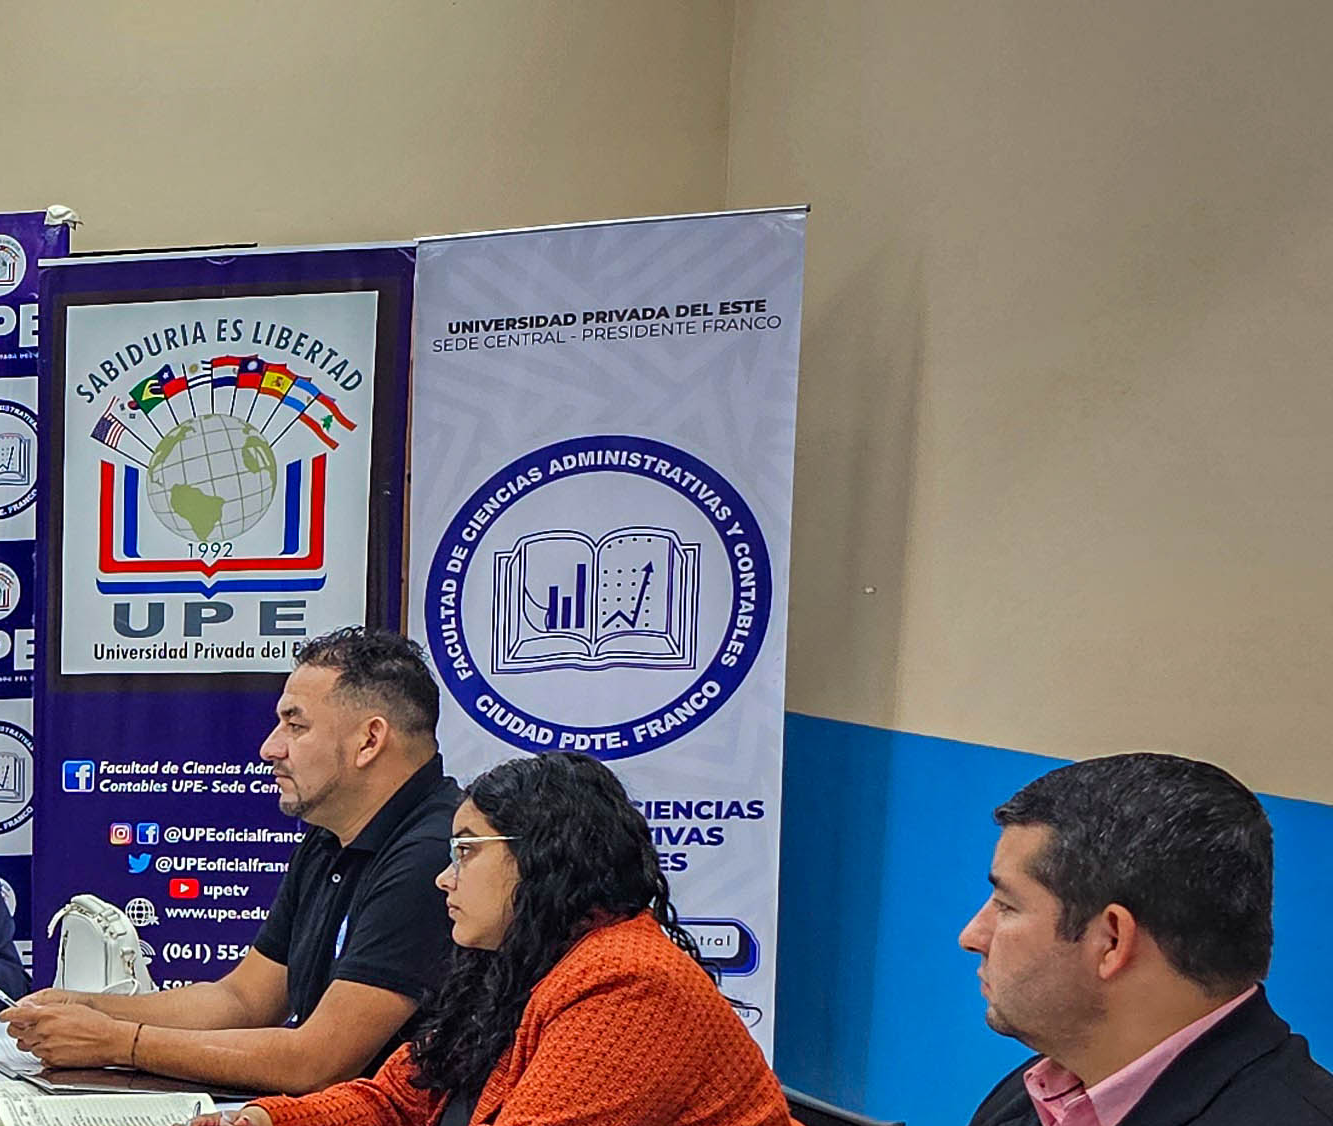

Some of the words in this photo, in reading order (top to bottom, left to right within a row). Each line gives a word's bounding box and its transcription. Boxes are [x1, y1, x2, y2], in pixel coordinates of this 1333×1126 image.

[432, 336, 479, 353] SEDE
[484, 330, 566, 350] CENTRAL
[581, 321, 697, 342] PRESIDENTE
[702, 315, 782, 335] FRANCO
[448, 312, 577, 335] UNIVERSIDAD
[582, 305, 671, 325] PRIVADA
[675, 302, 713, 319] DEL
[718, 299, 767, 315] ESTE
[76, 320, 208, 404] SABIDURIA
[216, 319, 244, 344] ES
[252, 321, 364, 393] LIBERTAD
[461, 466, 544, 542] CIENCIAS
[548, 450, 732, 523] ADMINISTRATIVAS
[724, 520, 744, 537] Y
[187, 542, 233, 559] 1992
[445, 539, 469, 575] DE
[112, 600, 308, 638] UPE
[720, 541, 757, 669] CONTABLES
[439, 579, 474, 681] FACULTAD
[93, 641, 189, 661] Universidad
[193, 641, 255, 660] Privada
[260, 640, 286, 659] del
[476, 694, 554, 748] CIUDAD
[559, 731, 629, 751] PDTE.
[633, 680, 721, 744] FRANCO
[99, 761, 160, 775] Facultad
[163, 761, 179, 774] de
[182, 761, 241, 775] Ciencias
[99, 779, 168, 793] Contables
[171, 780, 208, 793] UPE-
[212, 780, 246, 793] Sede
[163, 827, 306, 844] @UPEoficialfranc
[203, 884, 249, 899] upetv
[162, 943, 212, 963] (061)
